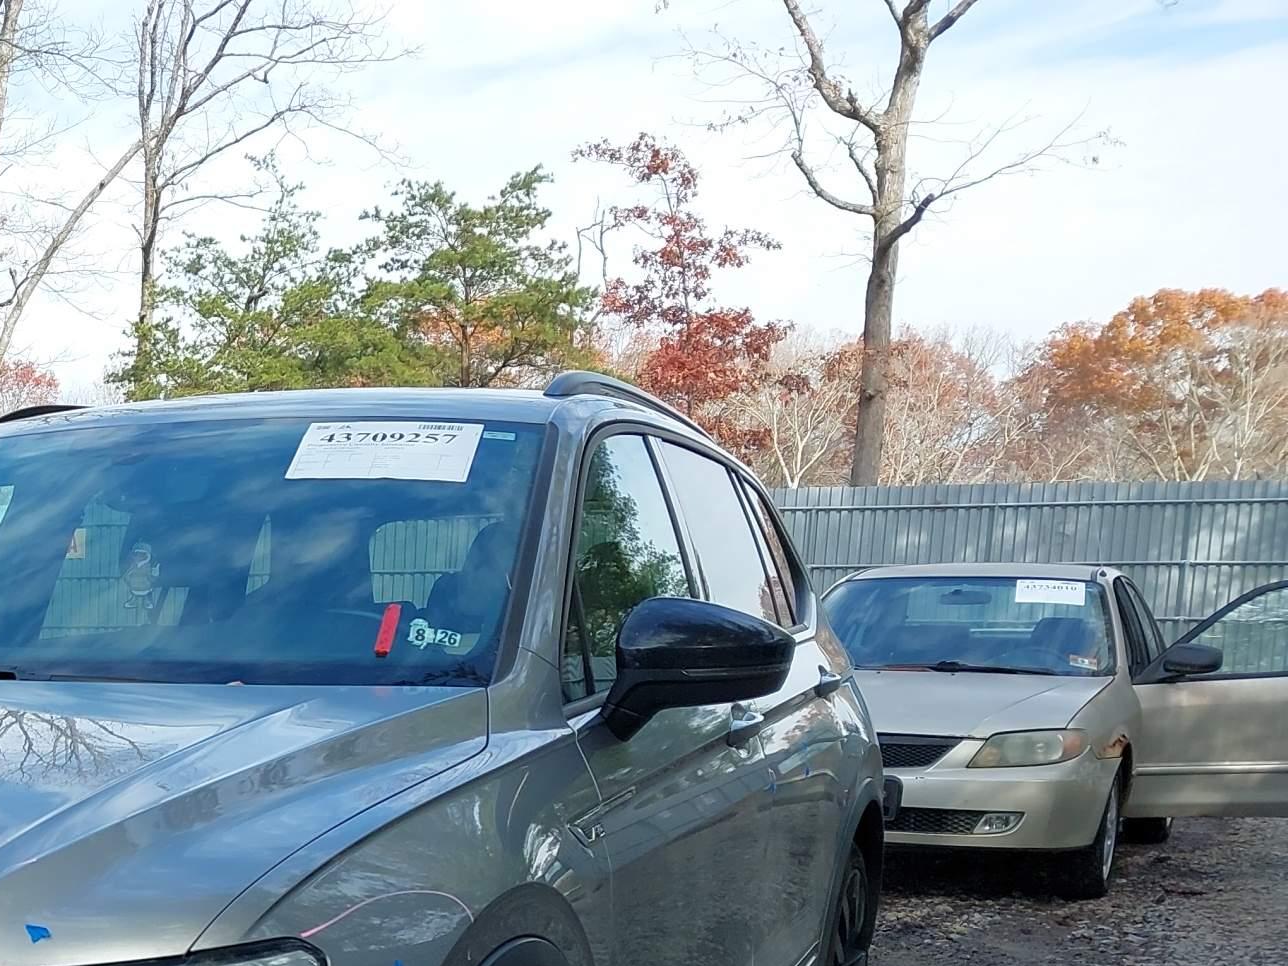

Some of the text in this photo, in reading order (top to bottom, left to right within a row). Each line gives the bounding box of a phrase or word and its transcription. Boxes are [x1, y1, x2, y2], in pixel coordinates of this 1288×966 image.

[319, 431, 457, 444] 43709257
[414, 627, 459, 646] 8 26
